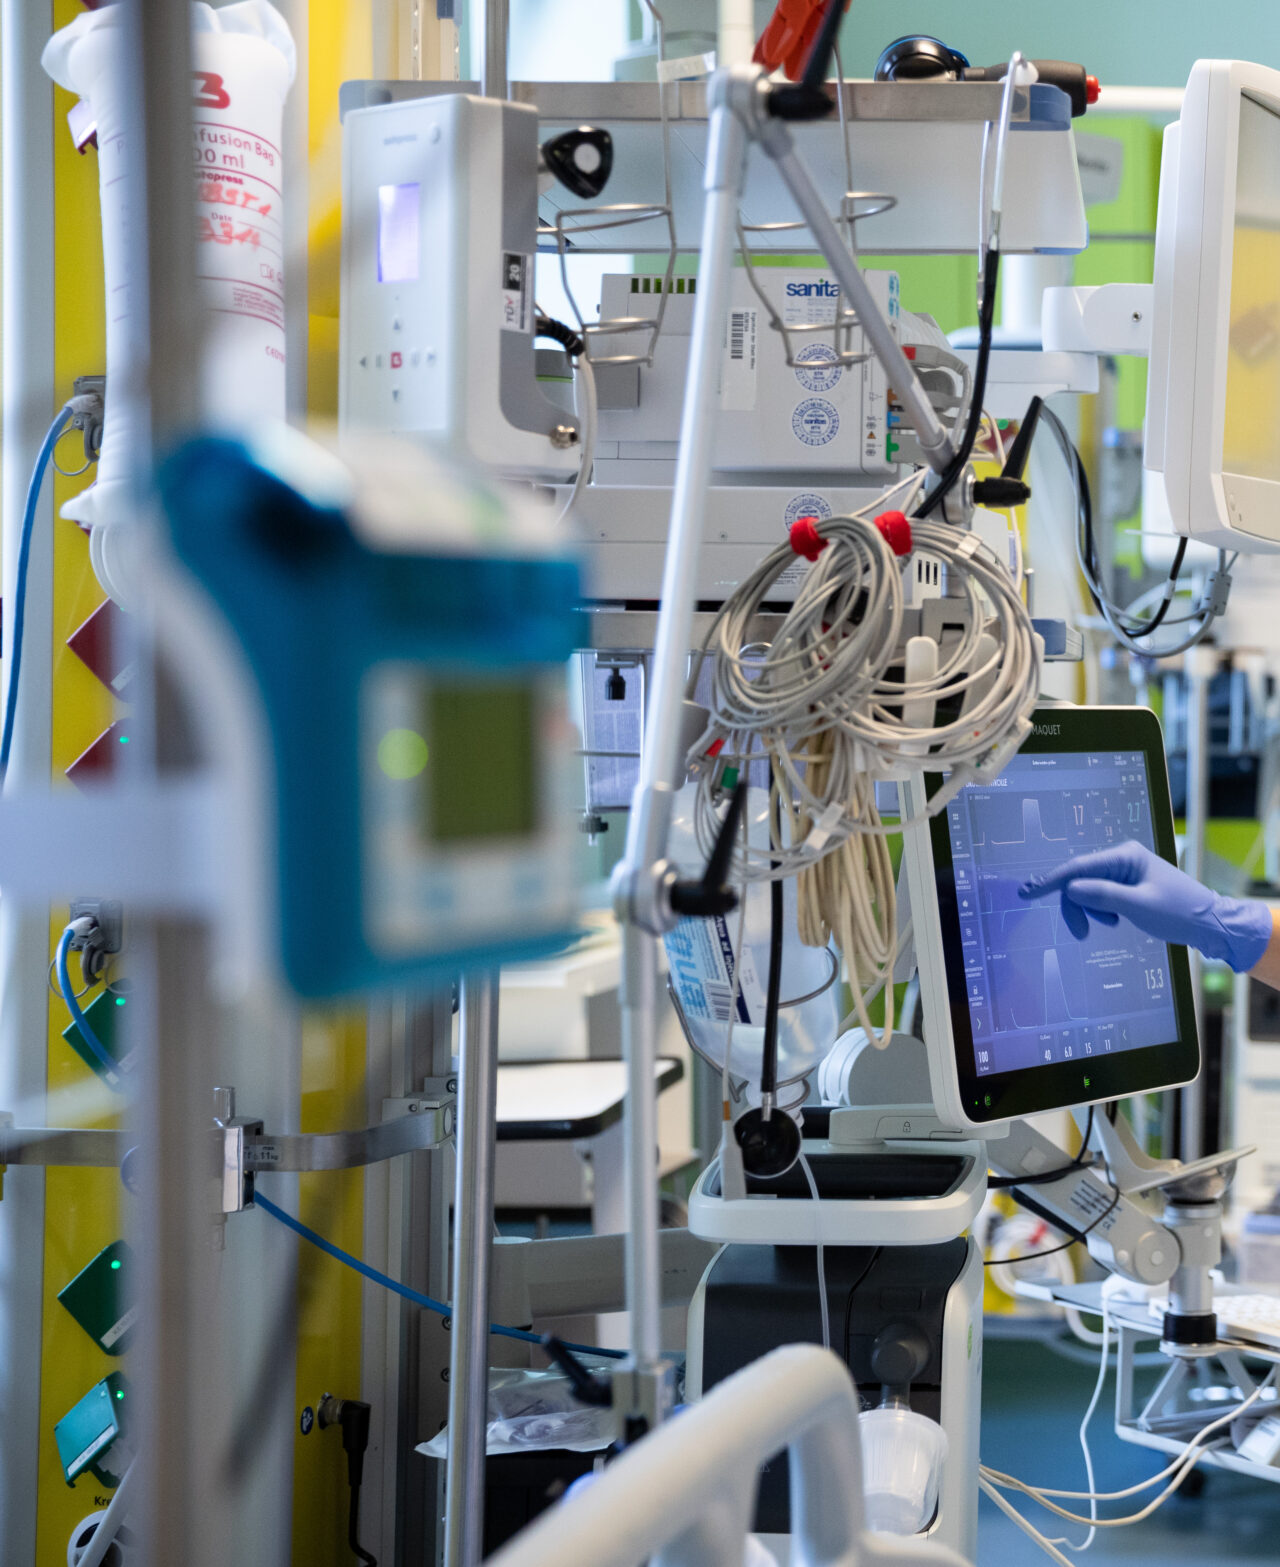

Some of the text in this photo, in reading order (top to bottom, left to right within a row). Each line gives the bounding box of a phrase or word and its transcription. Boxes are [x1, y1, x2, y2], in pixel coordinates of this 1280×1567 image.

[222, 154, 245, 169] ml
[254, 141, 275, 168] Bag
[1031, 724, 1061, 736] MAQUET
[1073, 805, 1084, 826] 17
[1144, 967, 1164, 990] 15.3
[978, 1051, 989, 1063] 100
[1085, 1042, 1092, 1055] 15
